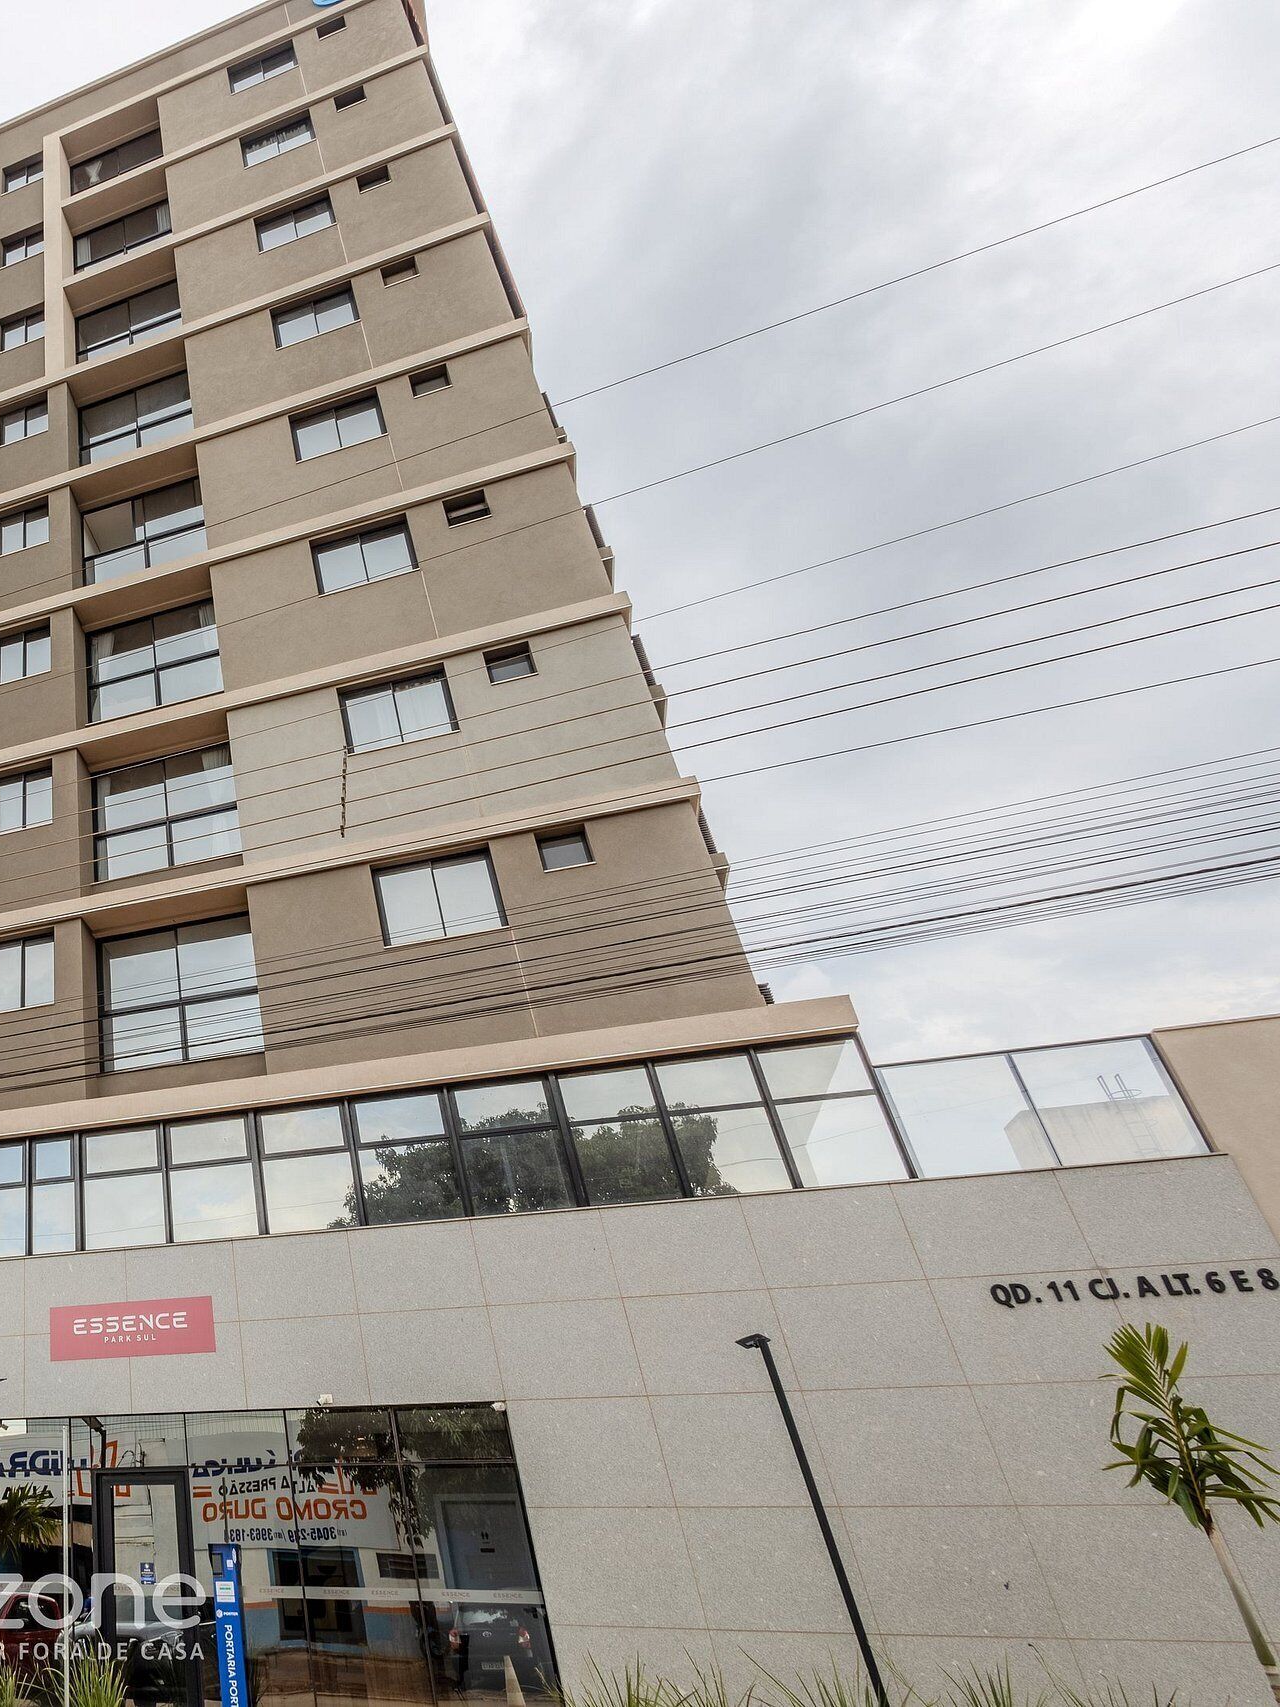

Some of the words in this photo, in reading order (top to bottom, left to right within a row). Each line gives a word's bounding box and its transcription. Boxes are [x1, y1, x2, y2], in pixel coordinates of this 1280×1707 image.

[990, 1283, 1043, 1309] QD.
[1047, 1280, 1081, 1302] 11
[1088, 1277, 1131, 1300] CJ.
[1205, 1271, 1226, 1294] 6
[1229, 1269, 1254, 1292] E
[1256, 1267, 1280, 1291] 8
[73, 1311, 188, 1335] ESSENCE
[104, 1334, 132, 1344] PARK
[136, 1333, 157, 1342] SUL
[224, 1624, 236, 1678] PORTARIA
